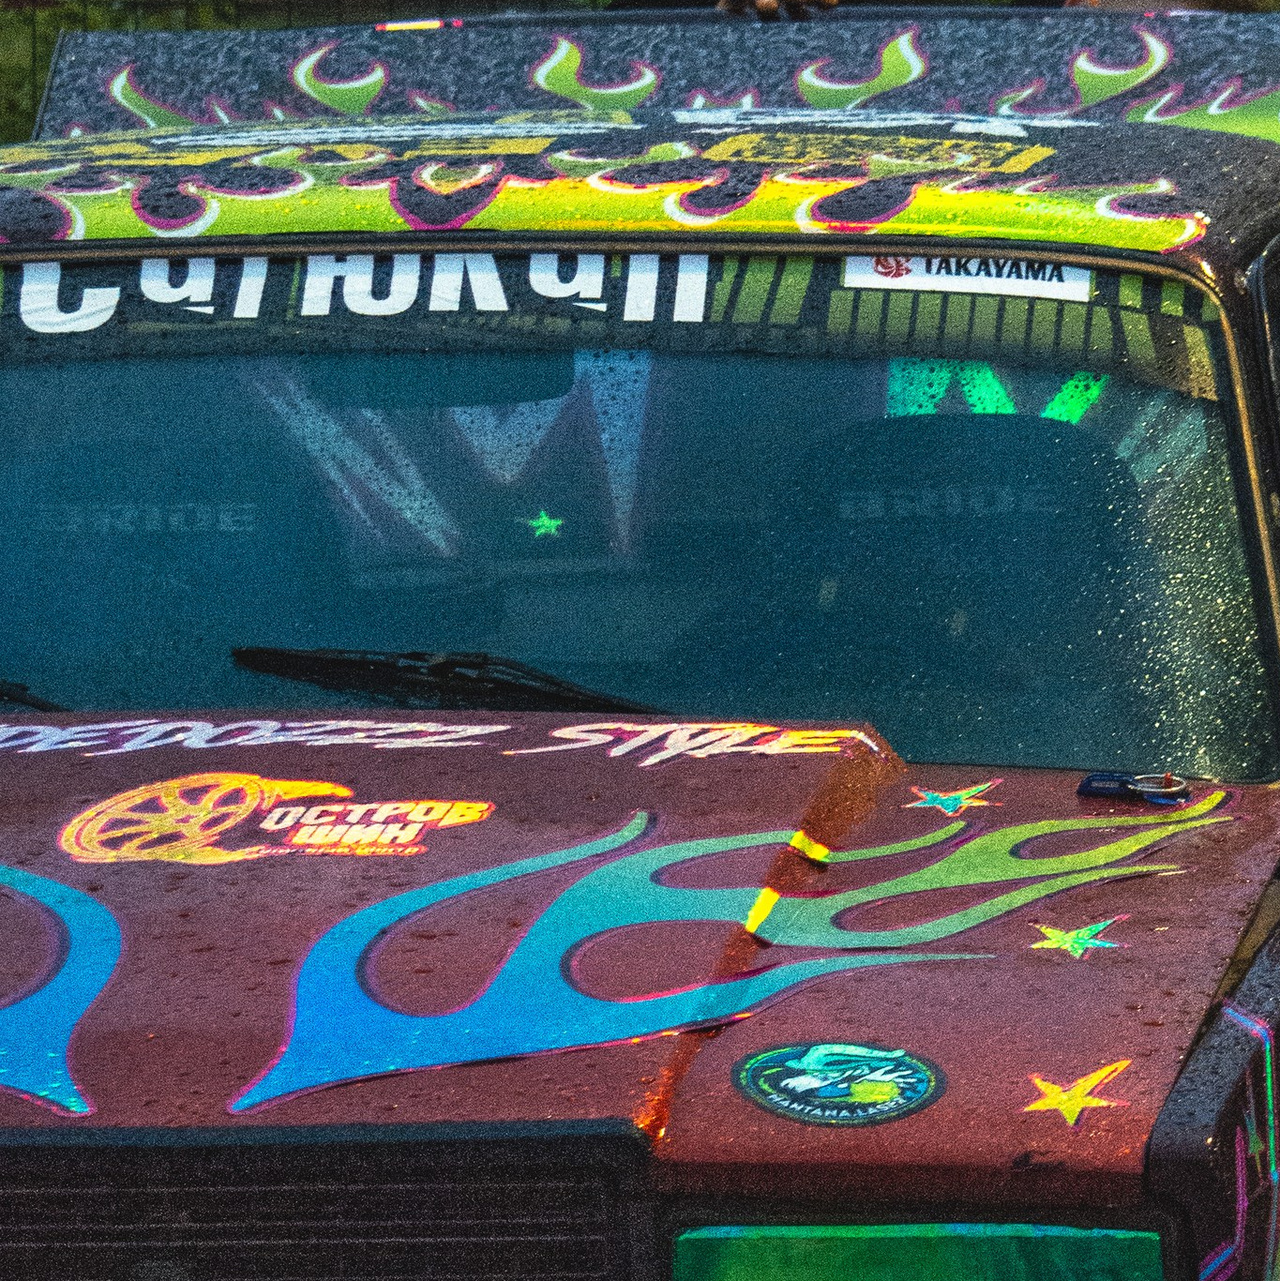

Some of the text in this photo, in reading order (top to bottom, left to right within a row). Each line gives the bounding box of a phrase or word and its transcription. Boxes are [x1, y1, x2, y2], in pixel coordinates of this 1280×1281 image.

[925, 256, 1065, 283] TAKAYAMA
[503, 722, 862, 767] STYLE
[259, 801, 490, 830] ОСТРОВ
[291, 822, 423, 844] ШИН
